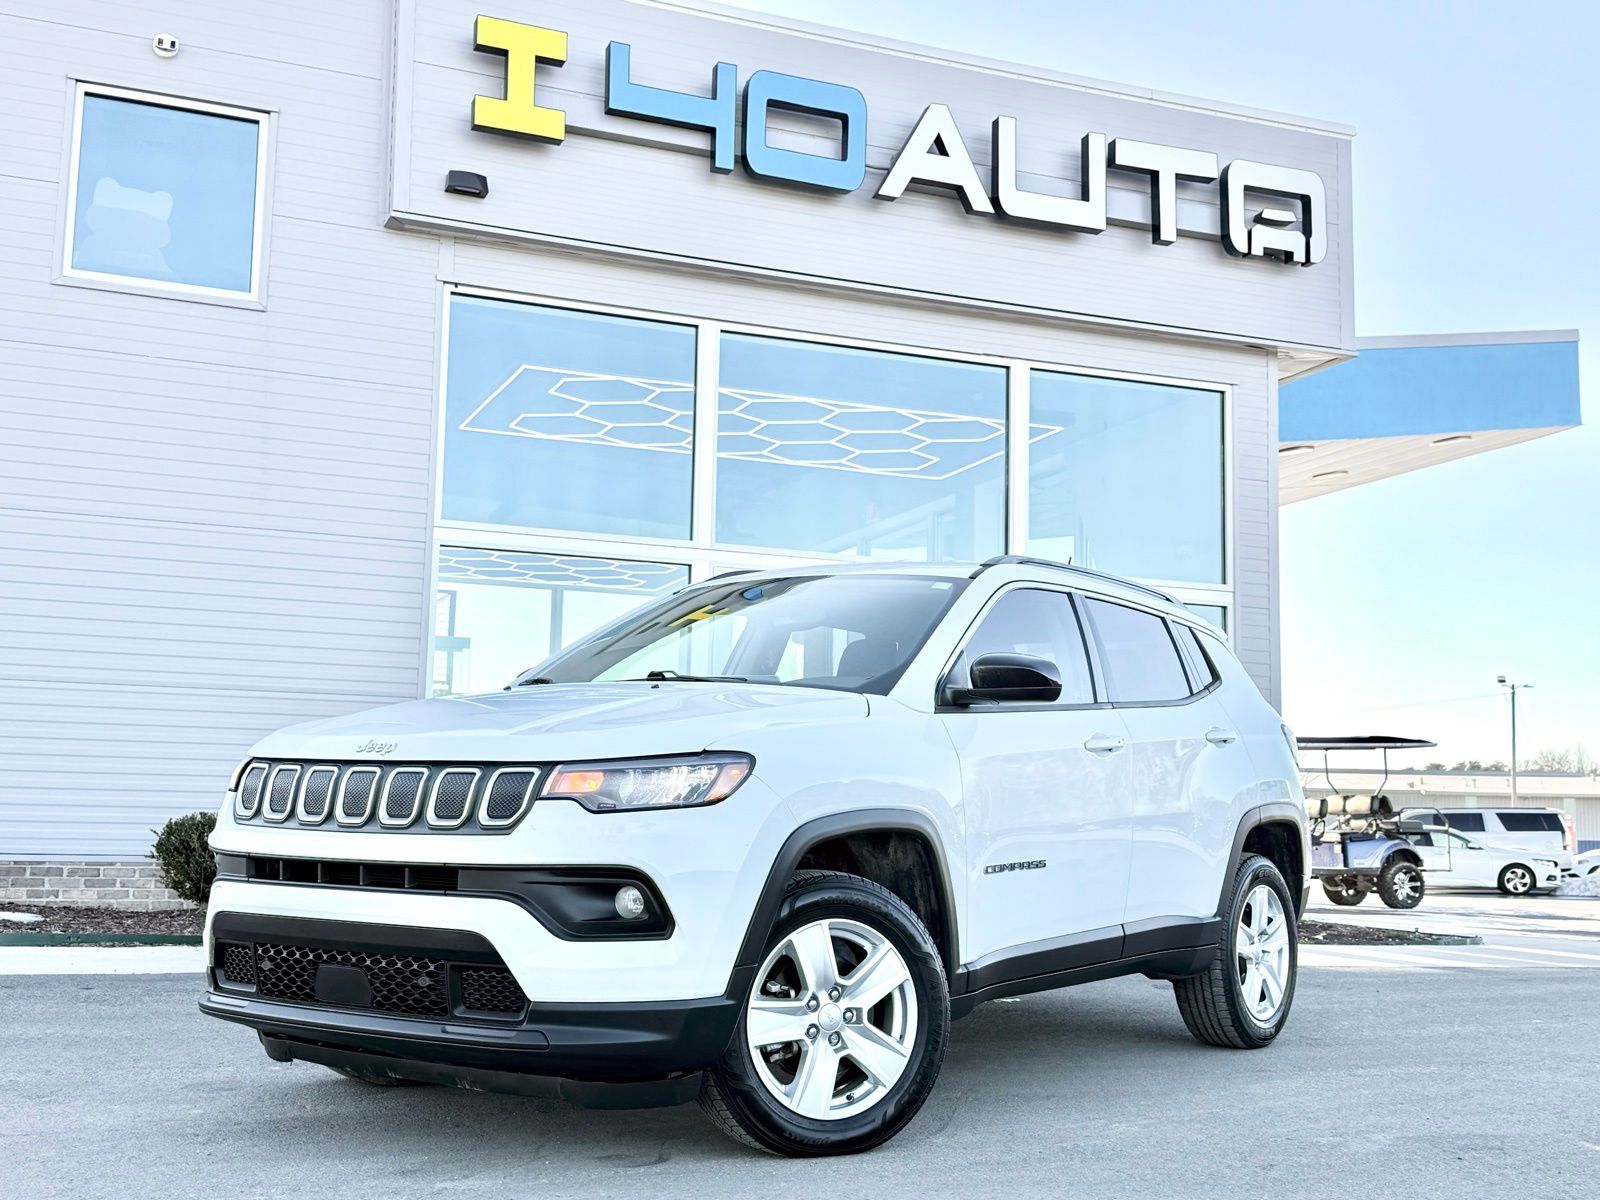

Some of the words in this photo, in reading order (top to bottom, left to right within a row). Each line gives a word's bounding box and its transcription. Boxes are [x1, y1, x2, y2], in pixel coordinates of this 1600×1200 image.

[471, 15, 568, 146] I
[604, 41, 867, 194] 40
[356, 739, 398, 756] Jeep
[983, 859, 1047, 875] COMPASS
